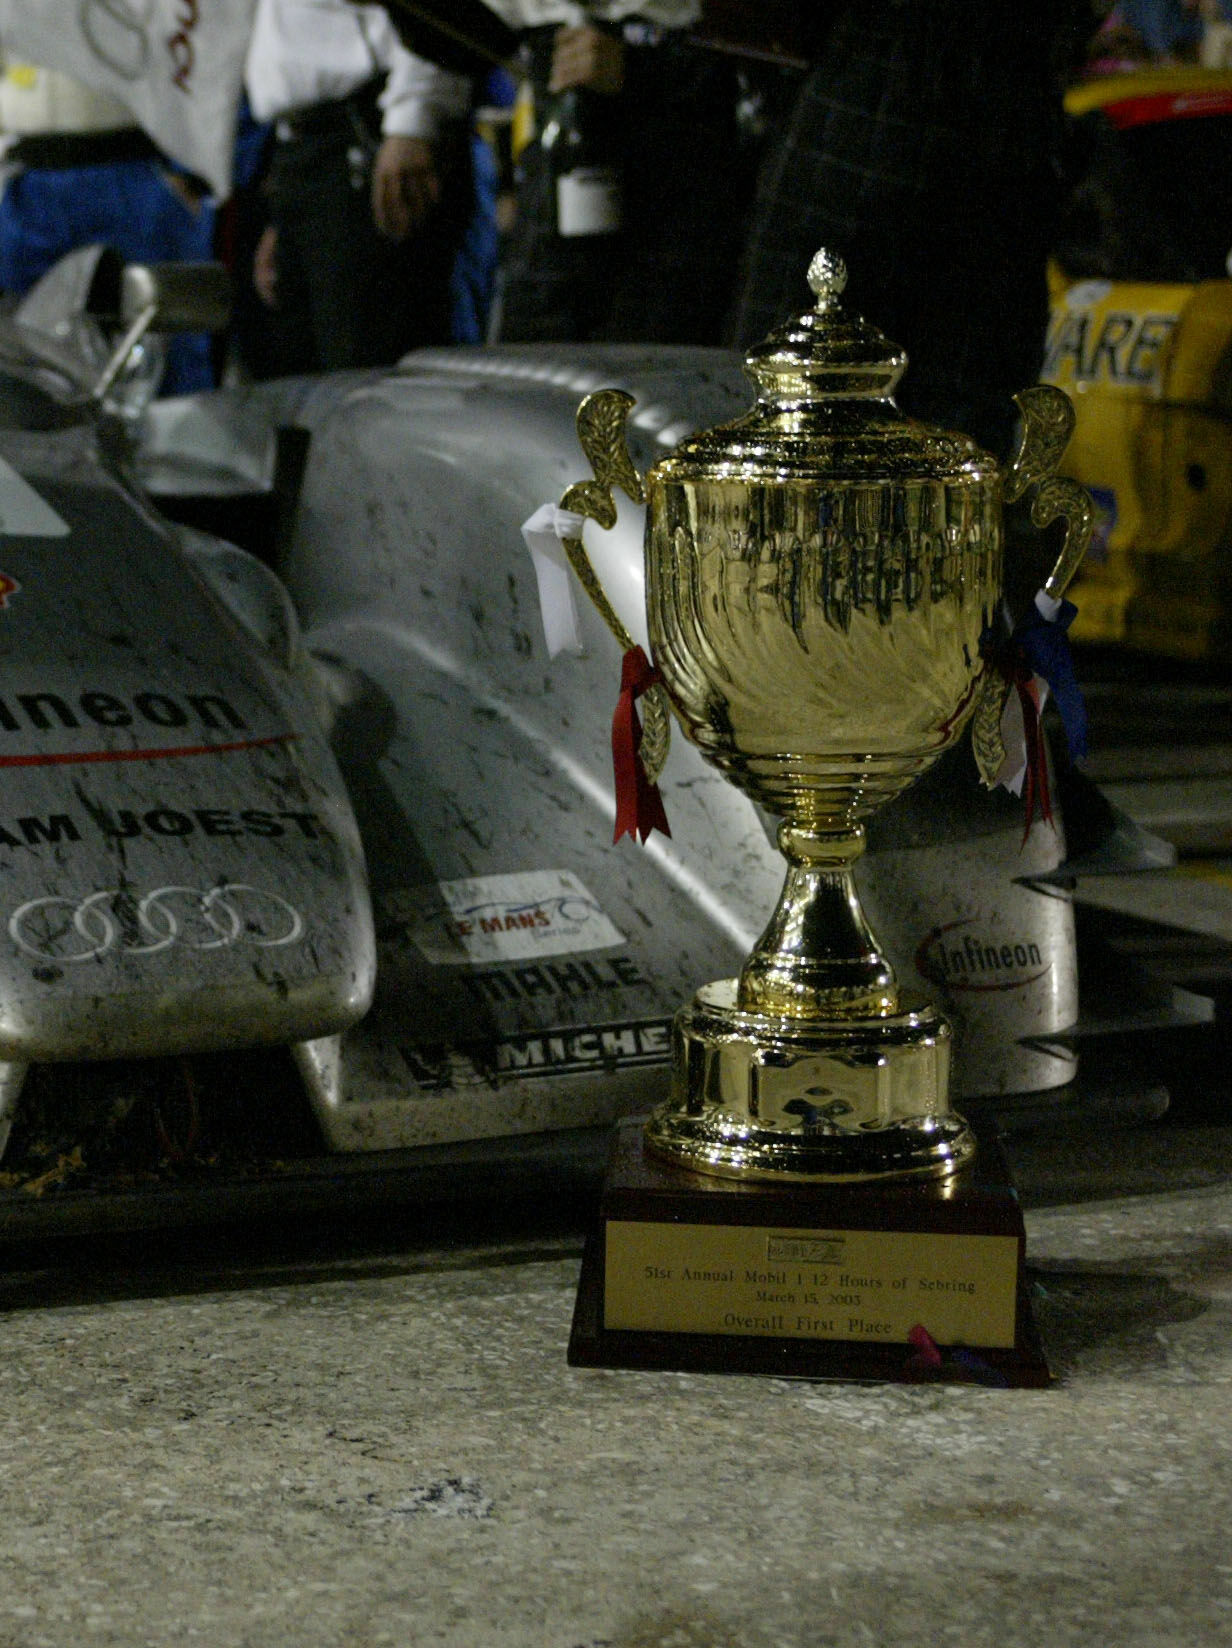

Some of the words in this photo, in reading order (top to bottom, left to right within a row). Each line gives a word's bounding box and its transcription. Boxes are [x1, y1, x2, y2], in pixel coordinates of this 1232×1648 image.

[1041, 312, 1181, 382] ARE
[106, 808, 321, 840] JOEST
[479, 908, 551, 934] MANS
[463, 957, 645, 1002] MAHLE
[682, 1268, 735, 1283] Annual
[745, 1270, 787, 1285] Mobil
[813, 1273, 829, 1287] 12
[840, 1274, 883, 1290] Hours
[892, 1277, 907, 1290] of
[919, 1279, 976, 1295] Sebring
[756, 1290, 795, 1304] March
[724, 1312, 784, 1330] Overall
[797, 1316, 834, 1332] First
[848, 1318, 893, 1334] Place
